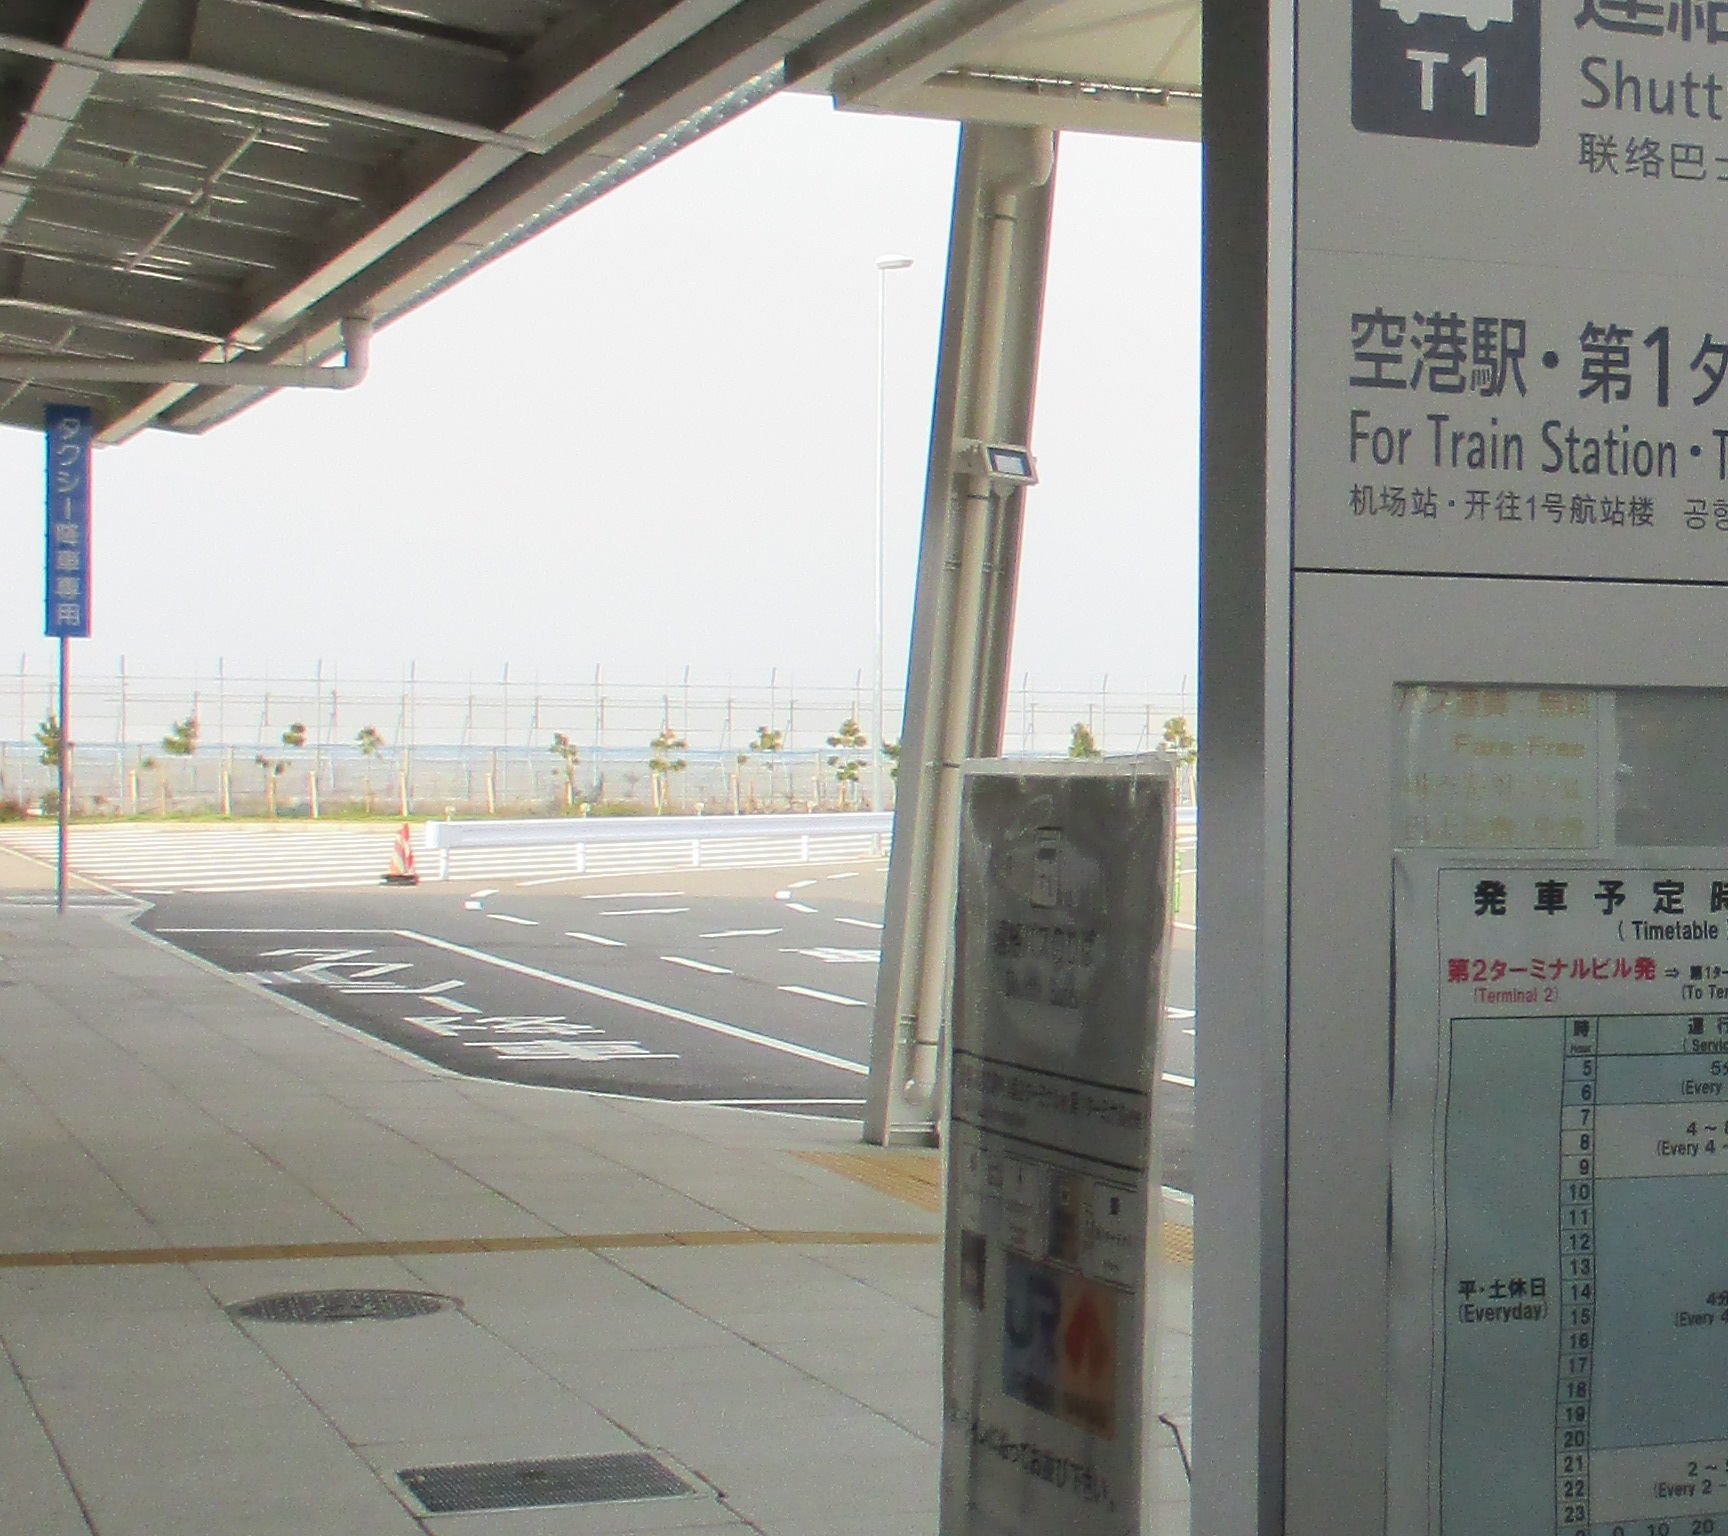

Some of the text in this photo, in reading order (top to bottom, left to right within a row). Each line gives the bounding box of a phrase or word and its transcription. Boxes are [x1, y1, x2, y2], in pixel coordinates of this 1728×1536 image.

[1406, 50, 1489, 117] T1
[1351, 410, 1411, 465] For
[1427, 414, 1523, 471] Train
[1448, 957, 1657, 982] 第2ターミナルビル発
[1583, 1060, 1592, 1076] 5
[1582, 1084, 1592, 1101] 6
[1580, 1109, 1590, 1126] 7
[1580, 1134, 1590, 1151] 8
[1705, 1139, 1716, 1154] 4
[1579, 1159, 1589, 1175] 9
[1570, 1184, 1590, 1200] 10
[1570, 1210, 1588, 1226] 11
[1570, 1234, 1590, 1251] 12
[1570, 1259, 1590, 1275] 13
[1571, 1284, 1590, 1300] 14
[1459, 1301, 1548, 1323] (Everyday)
[1570, 1308, 1590, 1325] 15
[1569, 1357, 1587, 1373] 17
[1567, 1381, 1587, 1398] 18
[1566, 1406, 1585, 1422] 19
[1564, 1431, 1585, 1448] 20
[1564, 1456, 1583, 1473] 21
[1564, 1481, 1585, 1497] 22
[1702, 1479, 1713, 1494] 2
[1564, 1506, 1585, 1522] 23
[1692, 1519, 1714, 1536] 20
